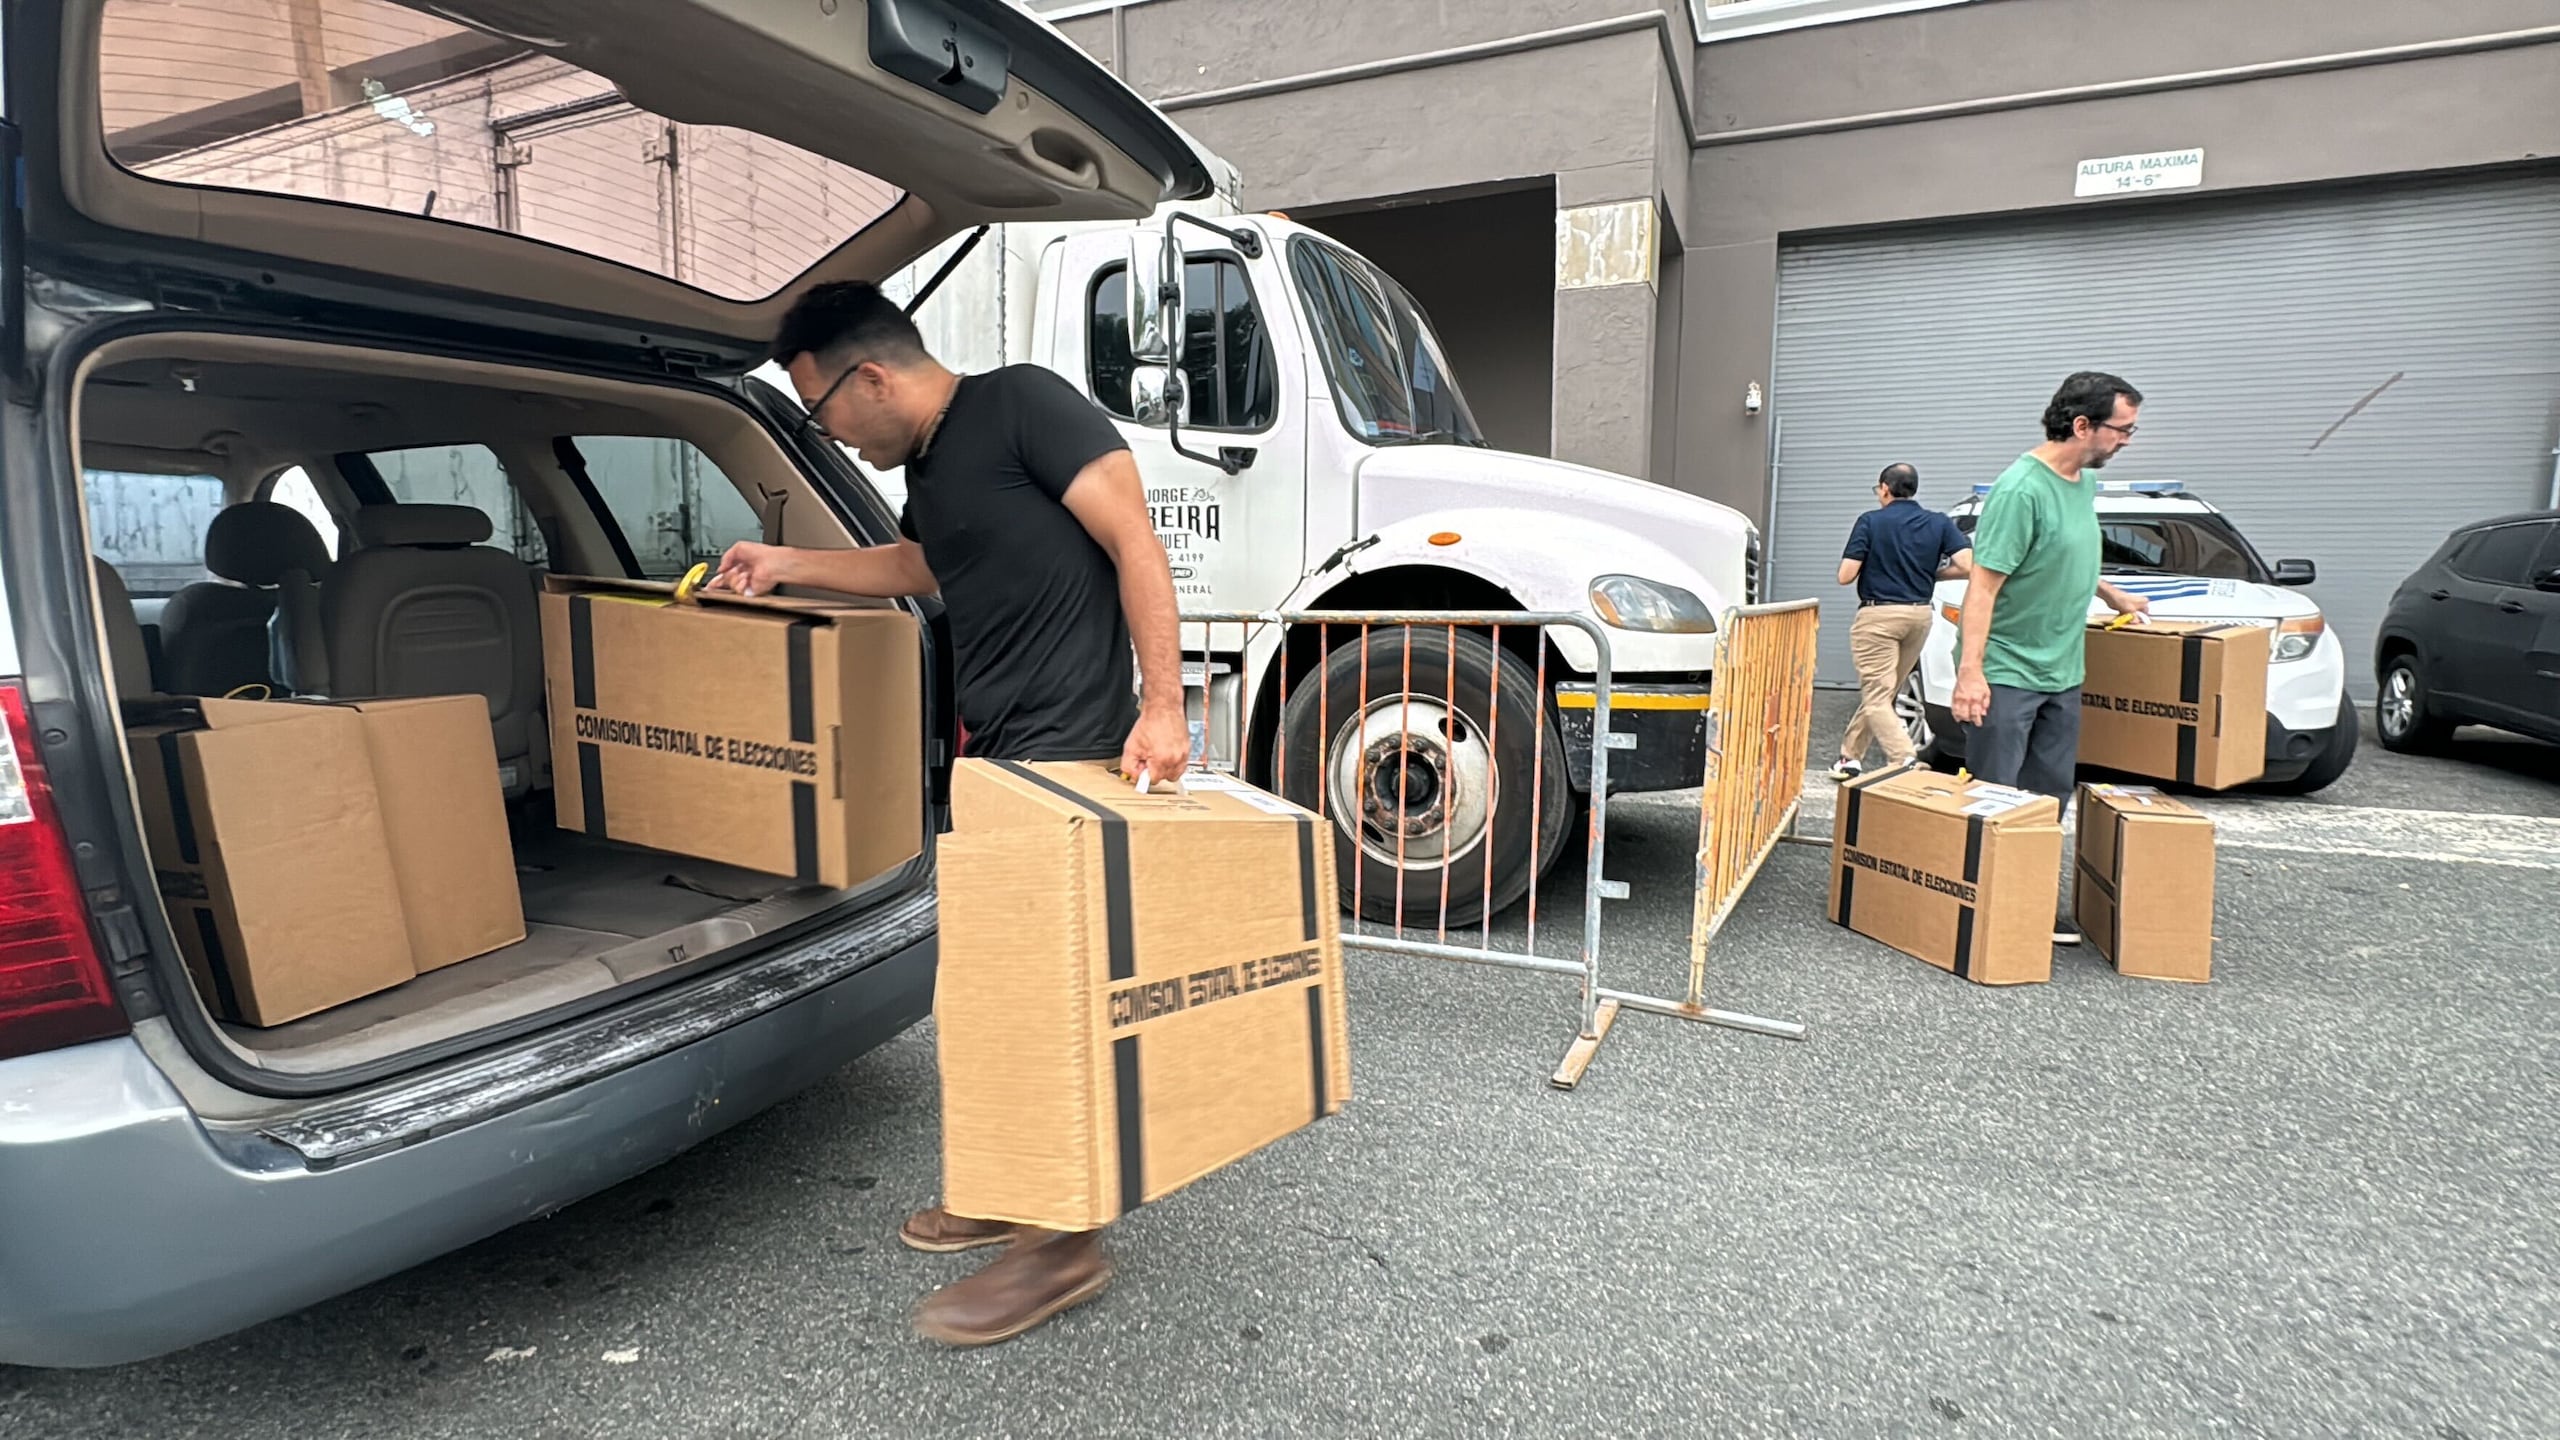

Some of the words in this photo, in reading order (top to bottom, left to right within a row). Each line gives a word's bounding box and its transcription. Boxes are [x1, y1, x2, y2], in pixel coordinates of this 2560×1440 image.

[2080, 160, 2134, 176] ALTURA
[2139, 153, 2199, 171] MAXIMA
[1145, 488, 1189, 504] JORGE
[1147, 504, 1221, 543] REIRA
[1178, 553, 1204, 562] 4199
[1174, 585, 1212, 594] NERAL
[2115, 697, 2129, 712] DE
[2131, 700, 2199, 722] ELECCIONES
[576, 714, 642, 746] COMISION
[645, 725, 702, 757] ESTATAL
[705, 735, 724, 761] DE
[728, 739, 817, 776] ELECCIONES
[1843, 848, 1878, 871] COMISION
[1879, 858, 1910, 882] ESTATAL
[1912, 868, 1923, 887] DE
[1925, 872, 1977, 903] ELECCIONES
